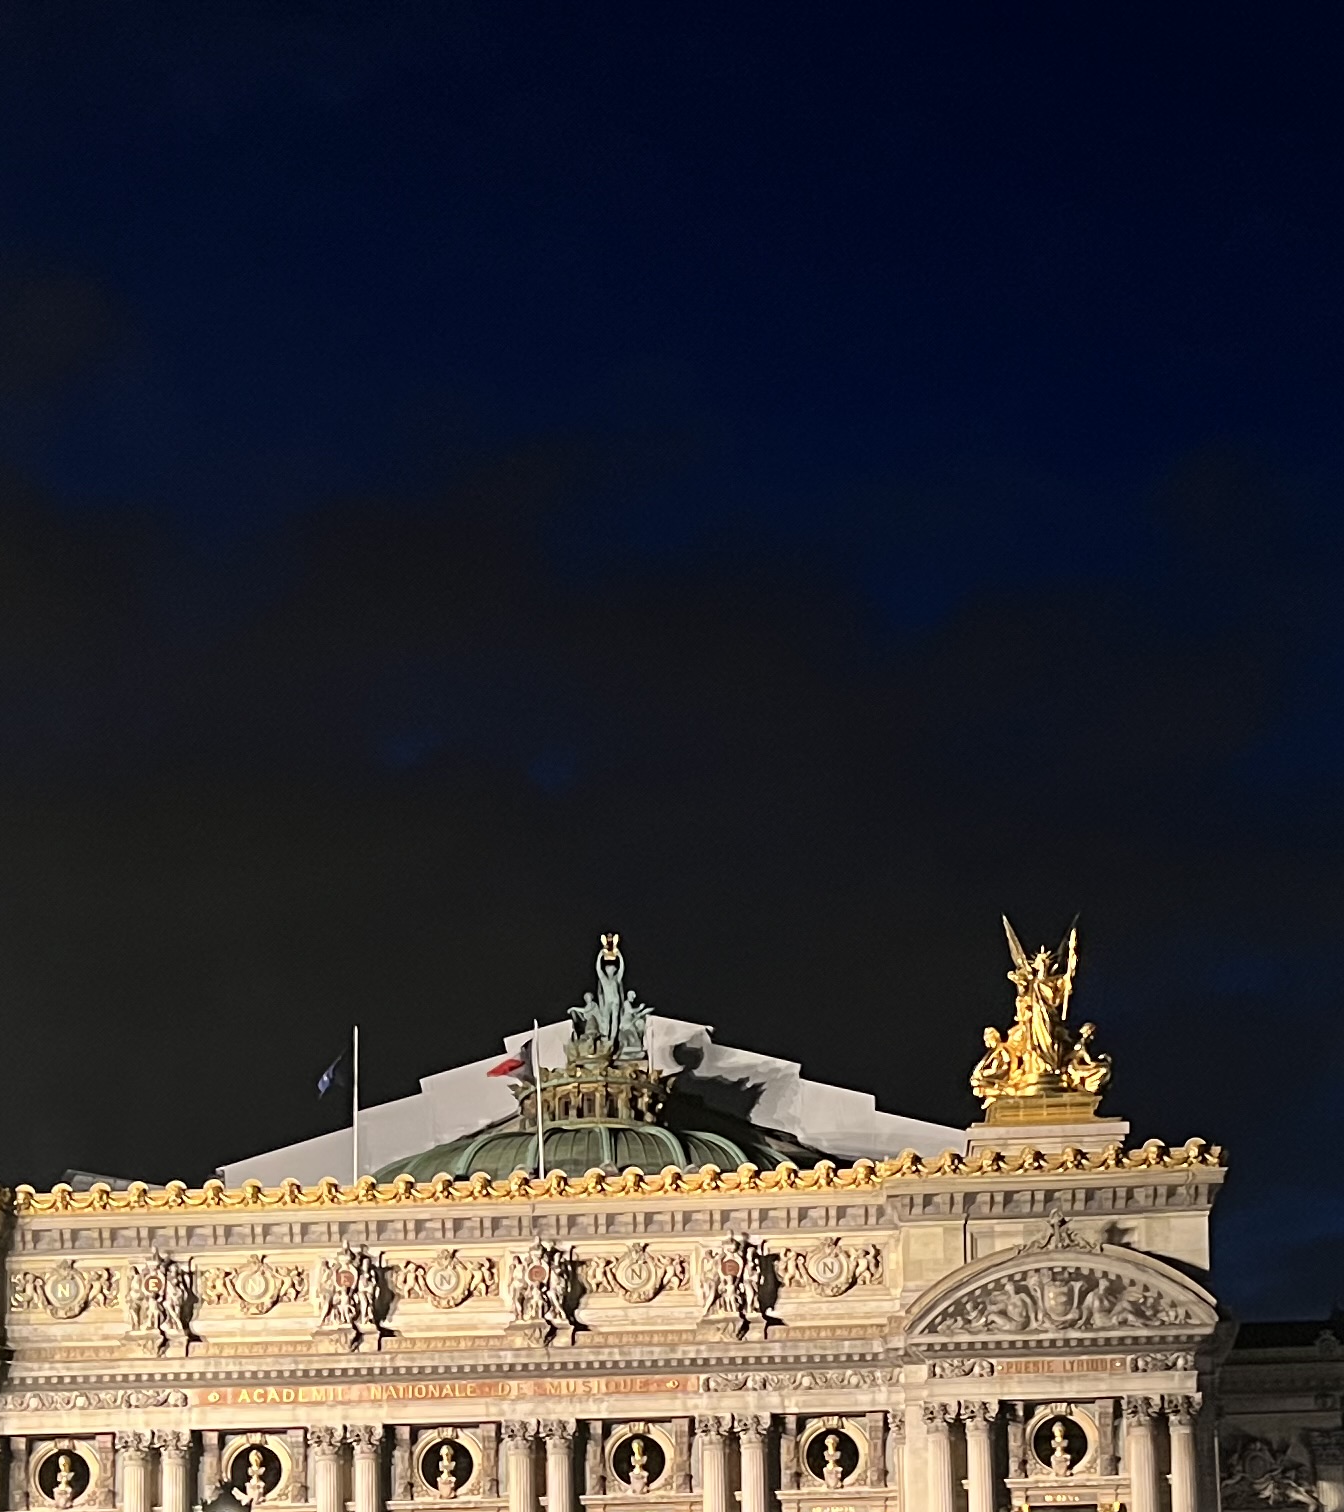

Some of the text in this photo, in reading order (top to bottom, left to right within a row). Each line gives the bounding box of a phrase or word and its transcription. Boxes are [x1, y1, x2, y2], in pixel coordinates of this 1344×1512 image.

[440, 1274, 452, 1286] N
[631, 1267, 642, 1280] N
[58, 1283, 70, 1297] N
[148, 1279, 159, 1291] E
[370, 1382, 477, 1400] NATIONALE
